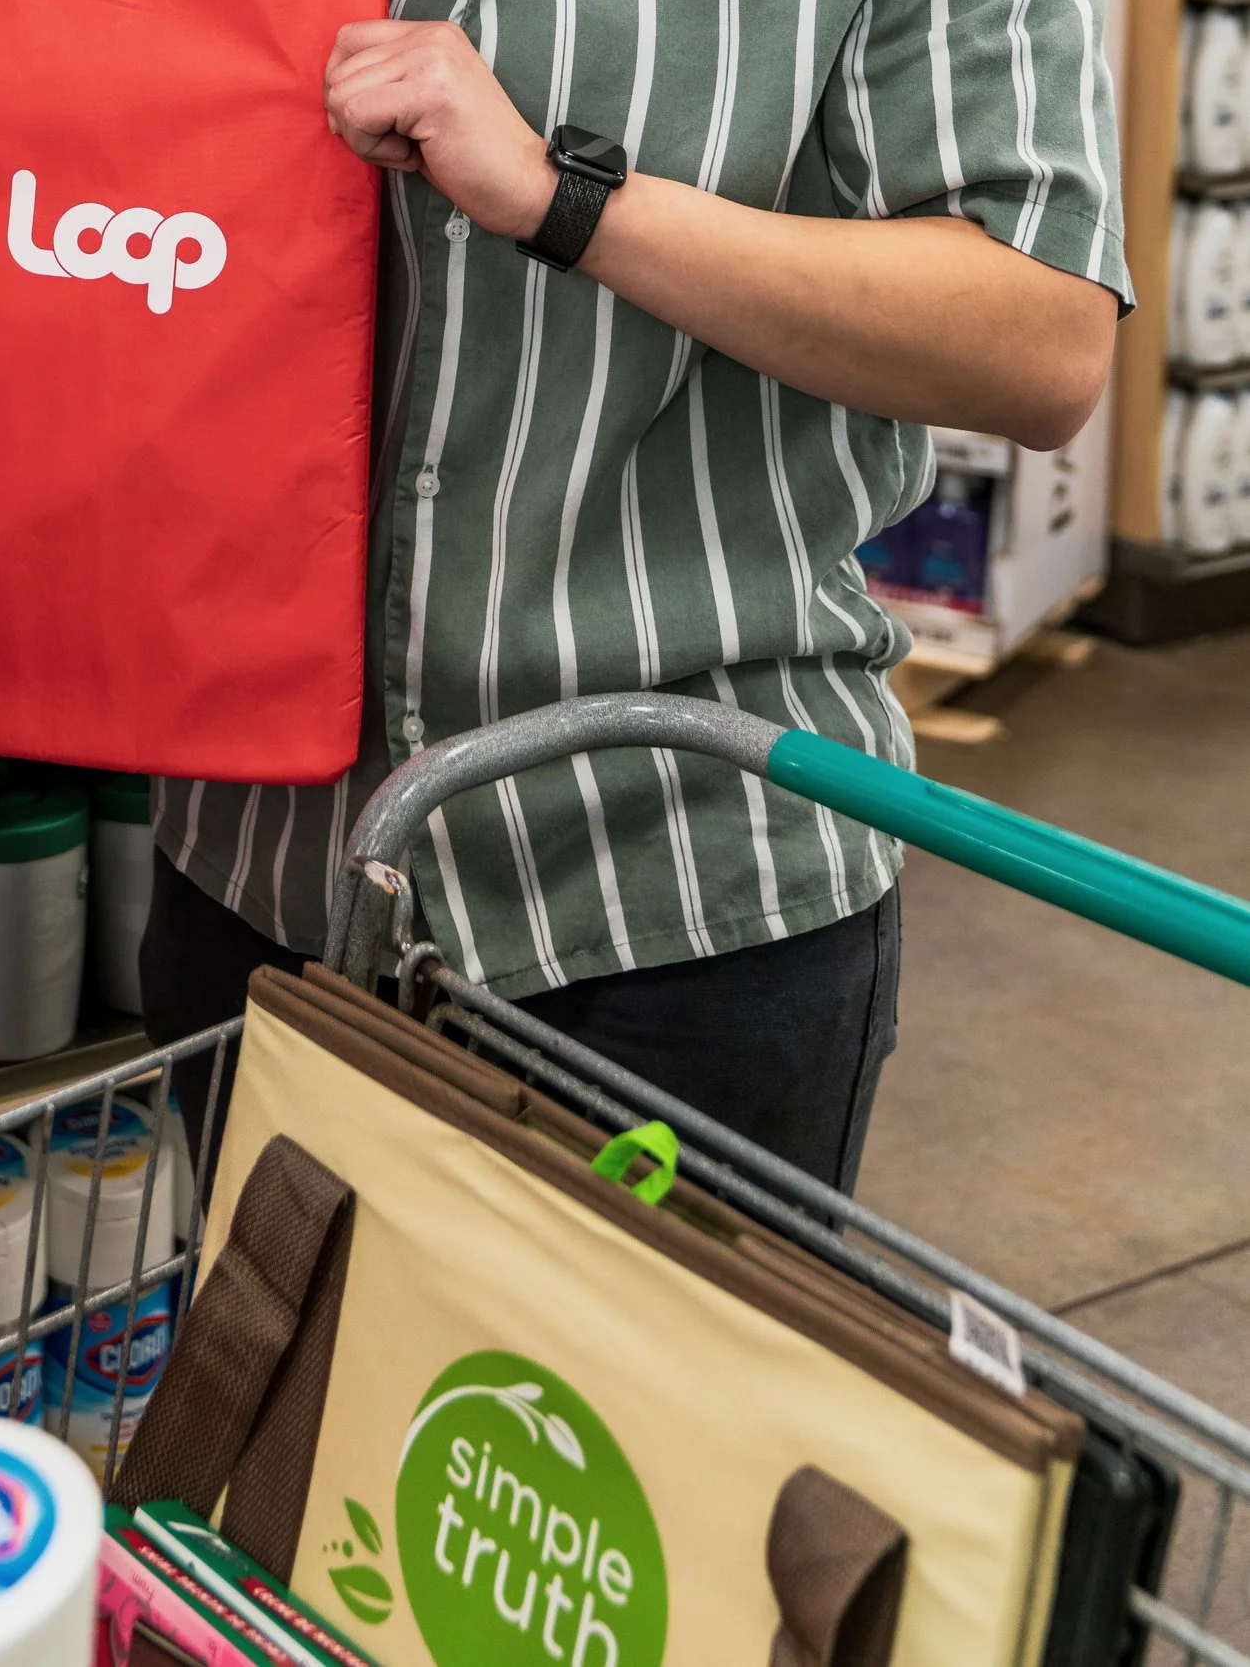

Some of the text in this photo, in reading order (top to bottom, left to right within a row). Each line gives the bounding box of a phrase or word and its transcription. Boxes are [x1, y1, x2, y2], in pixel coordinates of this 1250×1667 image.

[7, 169, 228, 315] Loop
[434, 1492, 618, 1667] truth
[446, 1436, 633, 1607] simple
